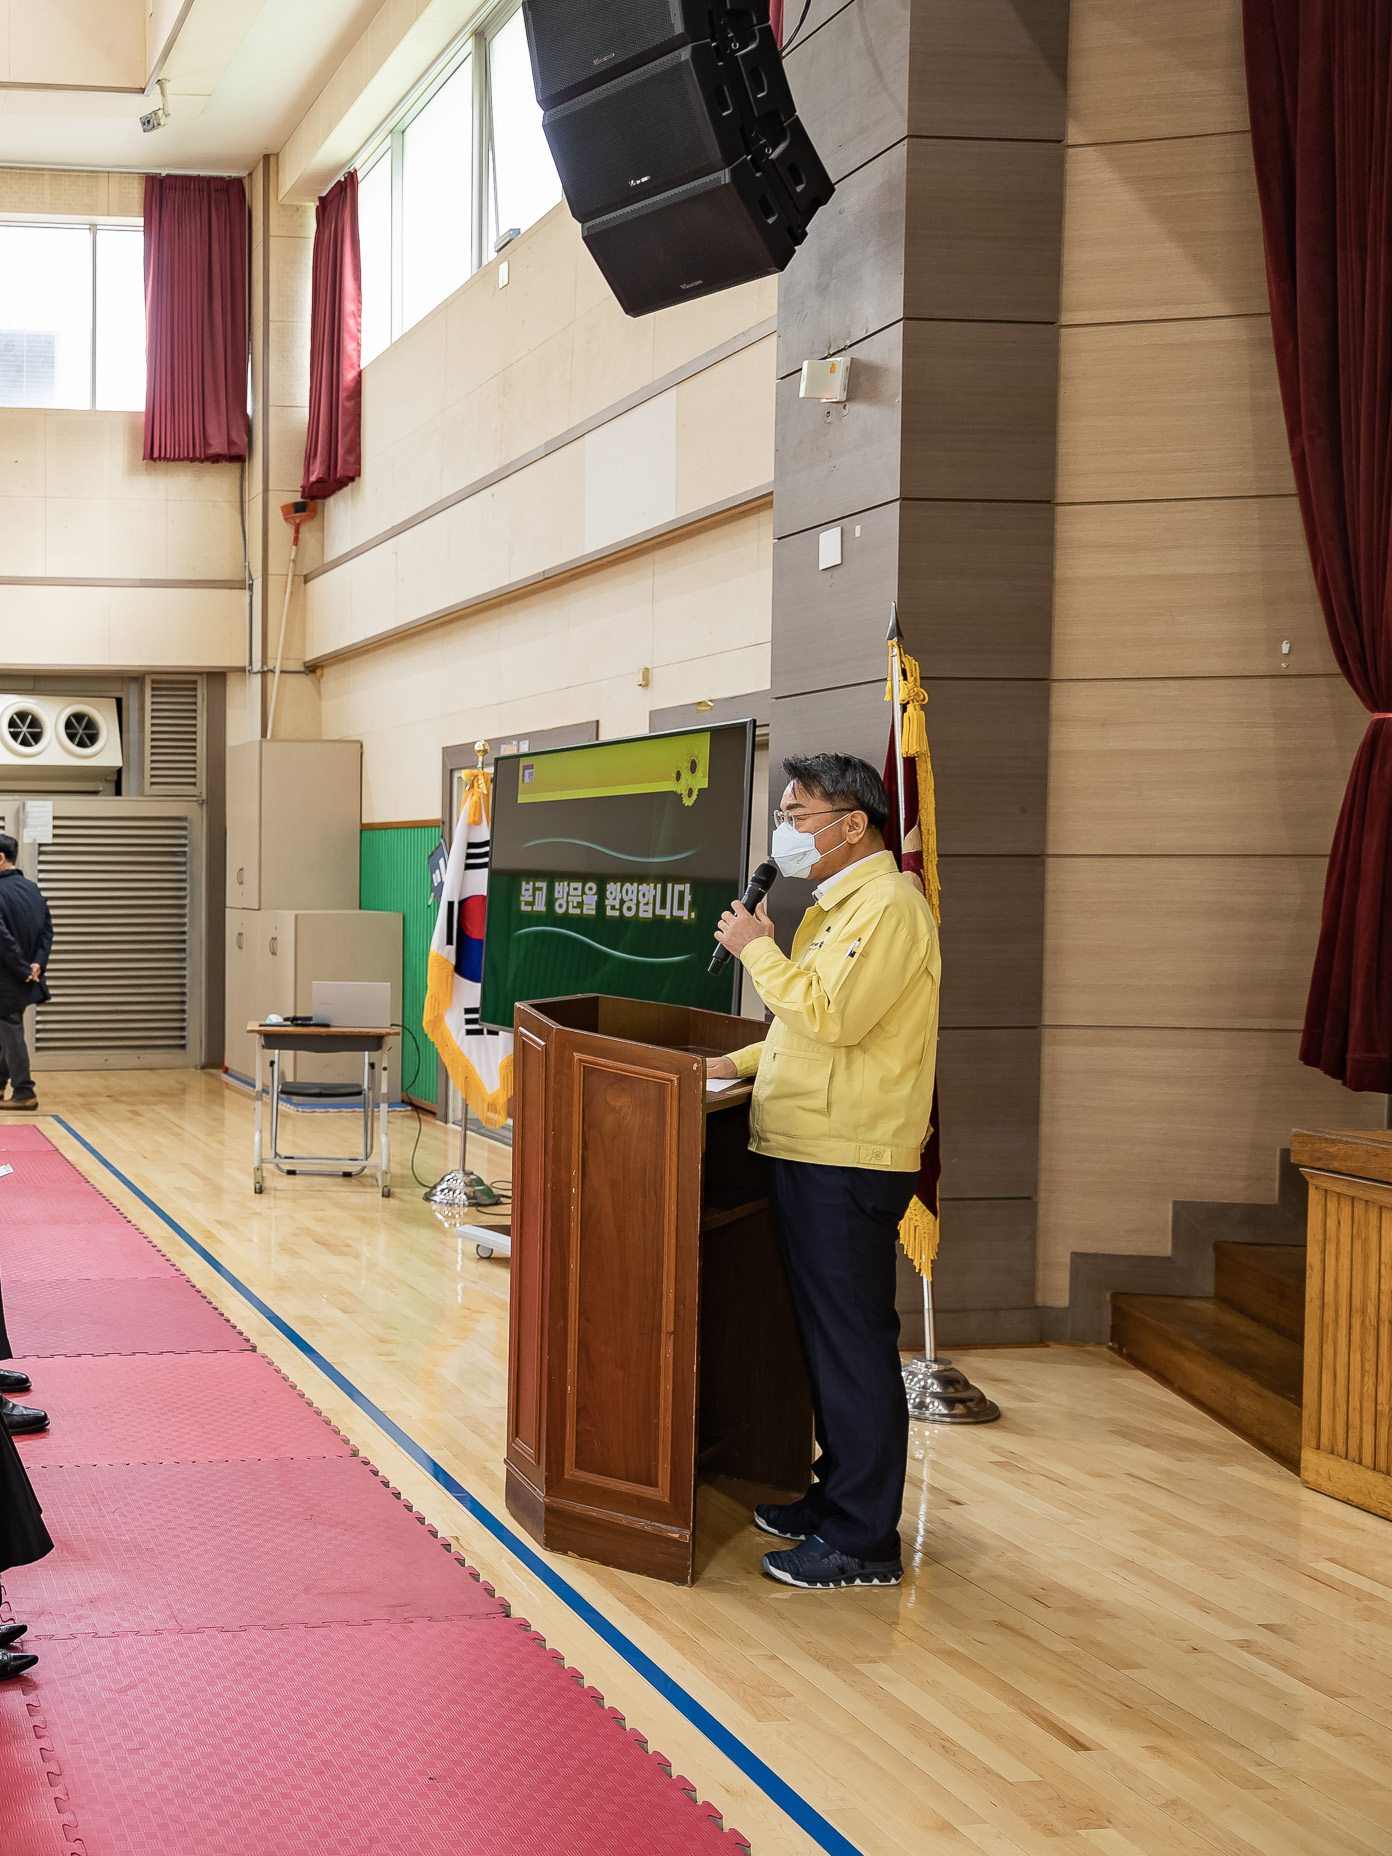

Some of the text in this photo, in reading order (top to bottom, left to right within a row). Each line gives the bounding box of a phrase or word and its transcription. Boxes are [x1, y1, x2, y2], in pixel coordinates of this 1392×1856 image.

[519, 881, 696, 920] 본교 방문을 환영합니다.
